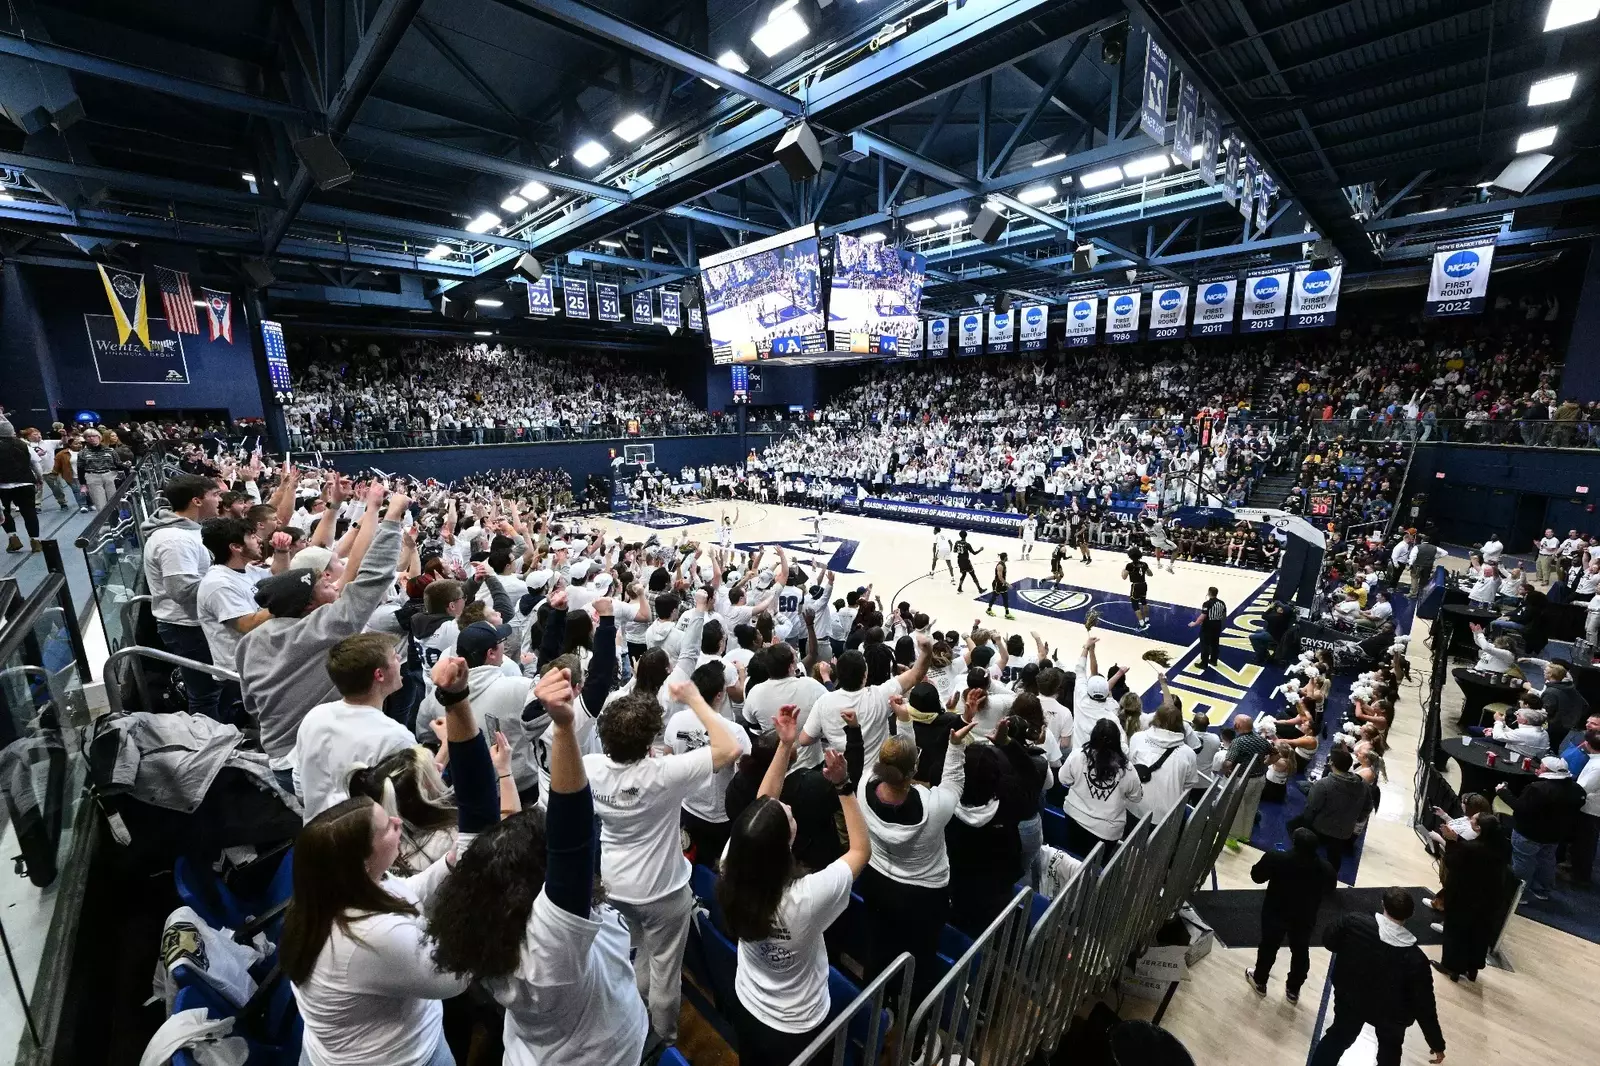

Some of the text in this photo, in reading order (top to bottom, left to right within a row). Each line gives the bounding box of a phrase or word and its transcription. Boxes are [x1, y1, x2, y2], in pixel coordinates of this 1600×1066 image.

[1456, 238, 1493, 248] BASKETBALL
[1447, 262, 1478, 272] NCAA
[1305, 280, 1330, 289] NCAA
[1445, 281, 1471, 289] FIRST
[1256, 287, 1279, 295] NCAA
[1441, 288, 1472, 296] ROUND
[532, 292, 550, 306] 24
[1206, 292, 1226, 301] NCAA
[1304, 296, 1325, 304] FIRST
[569, 296, 584, 309] 25
[603, 300, 615, 312] 31
[1300, 303, 1326, 311] ROUND
[1436, 301, 1470, 312] 2022
[636, 304, 650, 316] 42
[664, 308, 677, 319] 44
[1251, 320, 1274, 329] 2013
[1299, 315, 1324, 325] 2014
[1156, 328, 1177, 337] 2009
[1202, 324, 1222, 333] 2011
[96, 340, 141, 352] Wentz
[786, 340, 800, 353] A
[863, 501, 898, 511] SEASON-LONG
[898, 504, 929, 515] PRESENTER
[937, 510, 956, 518] AKRON
[957, 512, 971, 520] ZIPS
[971, 514, 990, 522] MEN'S
[1313, 504, 1327, 514] 30
[1141, 960, 1178, 969] JERZEES
